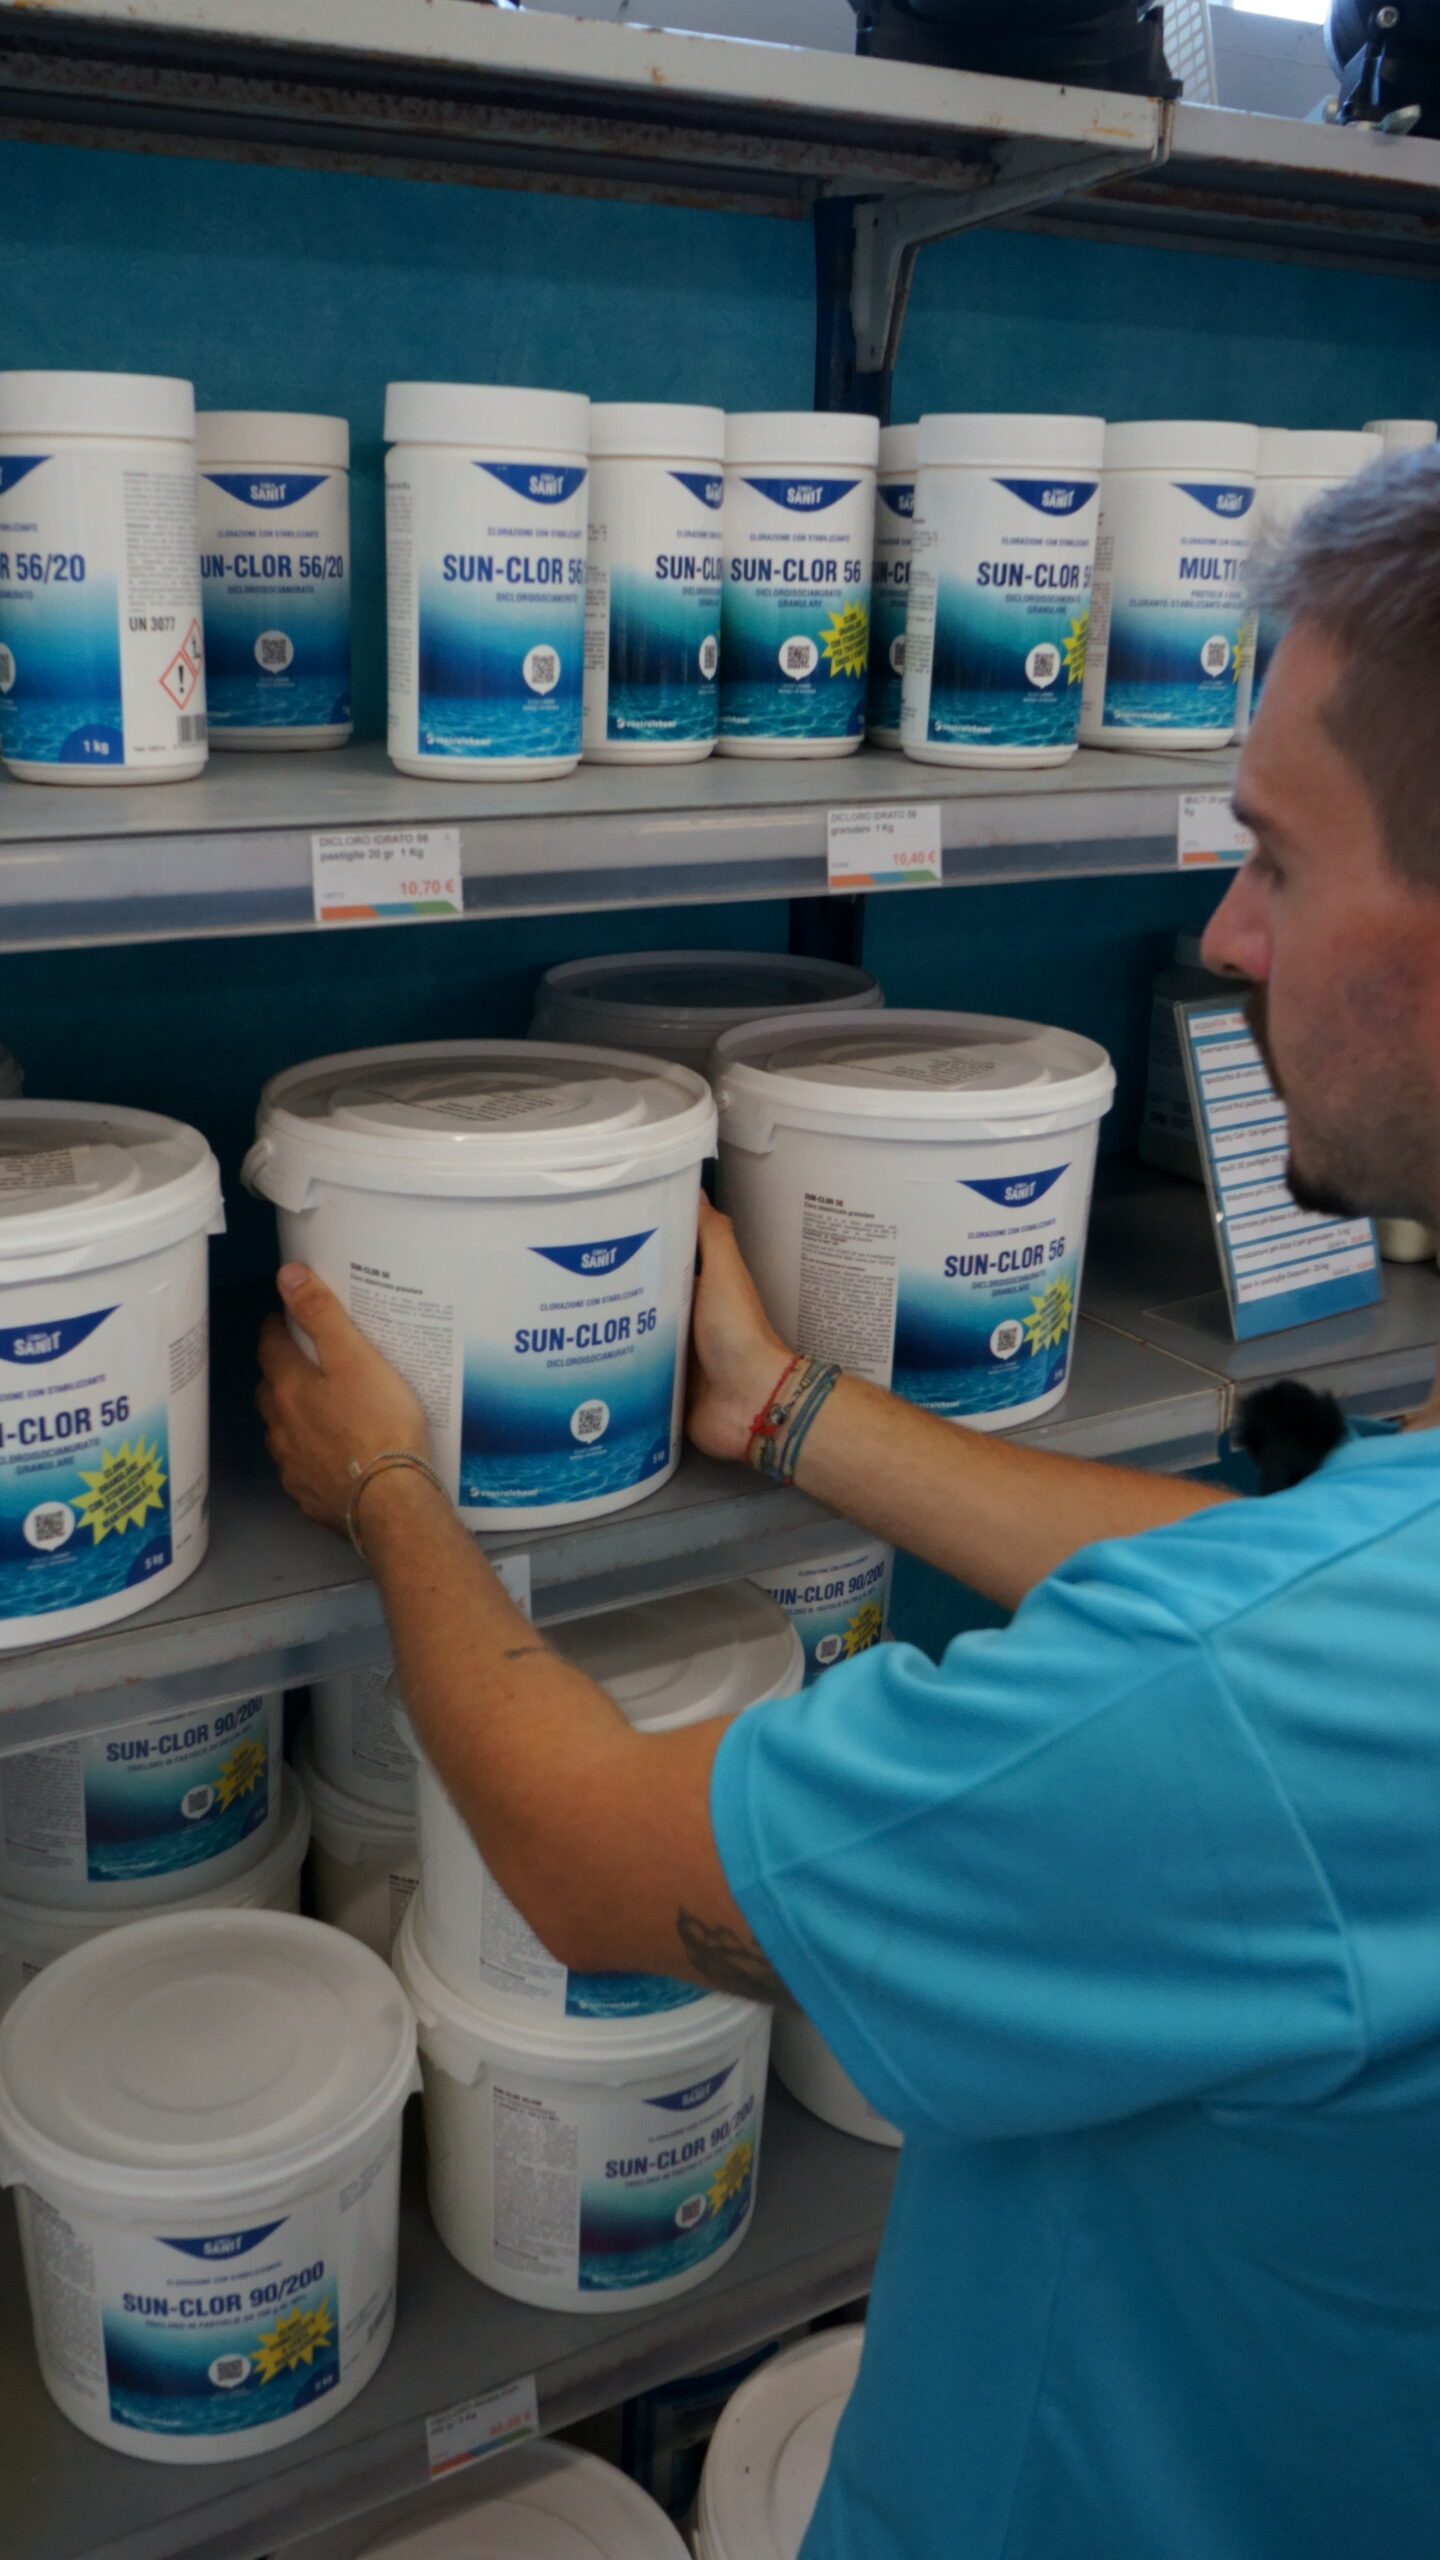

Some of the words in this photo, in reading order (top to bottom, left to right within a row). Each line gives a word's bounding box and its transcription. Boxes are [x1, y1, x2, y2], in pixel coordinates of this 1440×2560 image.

[250, 484, 287, 502] SANIT
[529, 475, 564, 497] SANIT
[787, 486, 823, 505] SANIT
[1042, 489, 1074, 508] SANIT
[16, 552, 86, 585] 56/20
[299, 555, 343, 580] 56/20
[443, 554, 563, 585] SUN-CLOR
[731, 558, 838, 583] SUN-CLOR
[844, 560, 861, 583] 56
[976, 561, 1079, 589] SUN-CLOR
[1179, 556, 1237, 581] MULTI
[129, 616, 147, 632] UN
[151, 617, 175, 632] 3077
[83, 740, 90, 752] 1
[830, 811, 871, 822] DICLORO
[873, 810, 905, 821] IDRATO
[319, 836, 371, 848] DICLORO
[373, 833, 413, 846] IDRATO
[831, 825, 871, 837] granulare
[882, 823, 894, 834] Kg
[320, 851, 365, 863] pastiglie
[368, 850, 381, 860] 20
[409, 848, 424, 860] Kg
[893, 851, 926, 866] 10,40
[927, 849, 936, 863] €
[400, 880, 441, 896] 10,70
[446, 879, 455, 894] €
[1004, 1181, 1037, 1201] SANIT
[581, 1247, 617, 1269] SANIT
[944, 1244, 1044, 1278] SUN-CLOR
[1048, 1235, 1065, 1261] 56
[540, 1300, 584, 1312] CLORAZIONE
[514, 1316, 630, 1354] SUN-CLOR
[637, 1307, 657, 1334] 56
[13, 1331, 61, 1356] SANIT
[28, 1386, 45, 1398] CON
[0, 1407, 92, 1447] -CLOR
[101, 1396, 129, 1427] 56
[16, 1456, 74, 1476] GRANULARE
[767, 1581, 844, 1605] UN-CLOR
[848, 1561, 885, 1593] 90/200
[106, 1724, 209, 1762] SUN-CLOR
[214, 1696, 263, 1738] 90/200
[605, 2137, 705, 2180] SUN-CLOR
[711, 2094, 755, 2146] 90/200
[204, 2235, 244, 2256] SANIT
[122, 2293, 242, 2318] SUN-CLOR
[250, 2260, 324, 2308] 90/200
